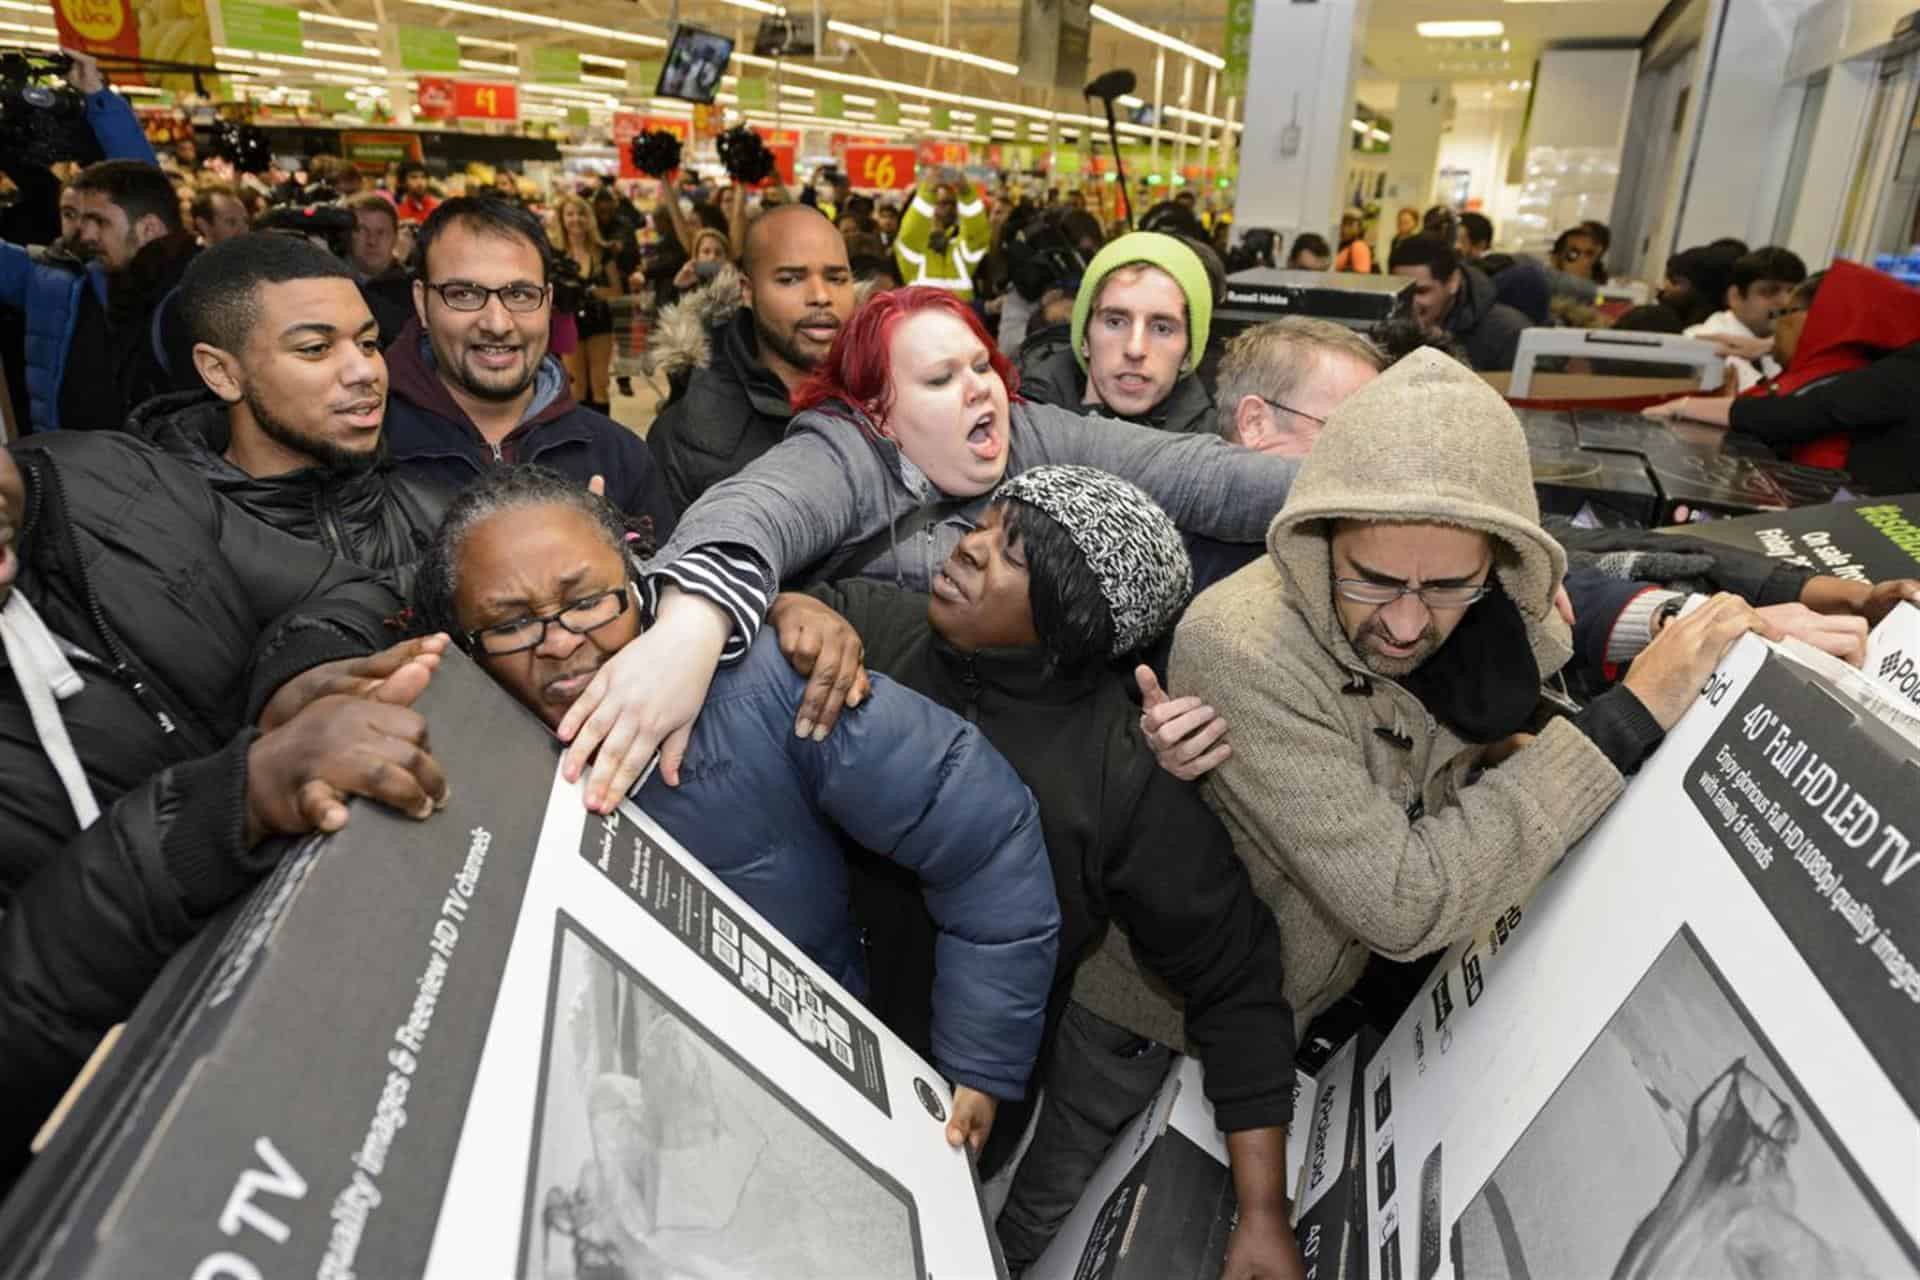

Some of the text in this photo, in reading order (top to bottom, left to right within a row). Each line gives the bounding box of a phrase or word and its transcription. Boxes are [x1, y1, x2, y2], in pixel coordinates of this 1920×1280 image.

[863, 153, 896, 188] £6
[1712, 786, 1741, 828] family
[1740, 822, 1775, 870] friends
[1742, 703, 1920, 886] 40" Full HD LED TV
[455, 826, 492, 898] channels
[1716, 743, 1742, 781] Enjoy
[1731, 770, 1771, 814] glorious
[1764, 801, 1790, 834] Full
[1780, 820, 1805, 850] HD
[1830, 887, 1880, 945] quality
[429, 919, 460, 957] HD
[442, 887, 470, 921] TV
[395, 952, 449, 1053] Freeview
[387, 1048, 417, 1075] &
[351, 1071, 411, 1176] images
[218, 1136, 308, 1243] TV
